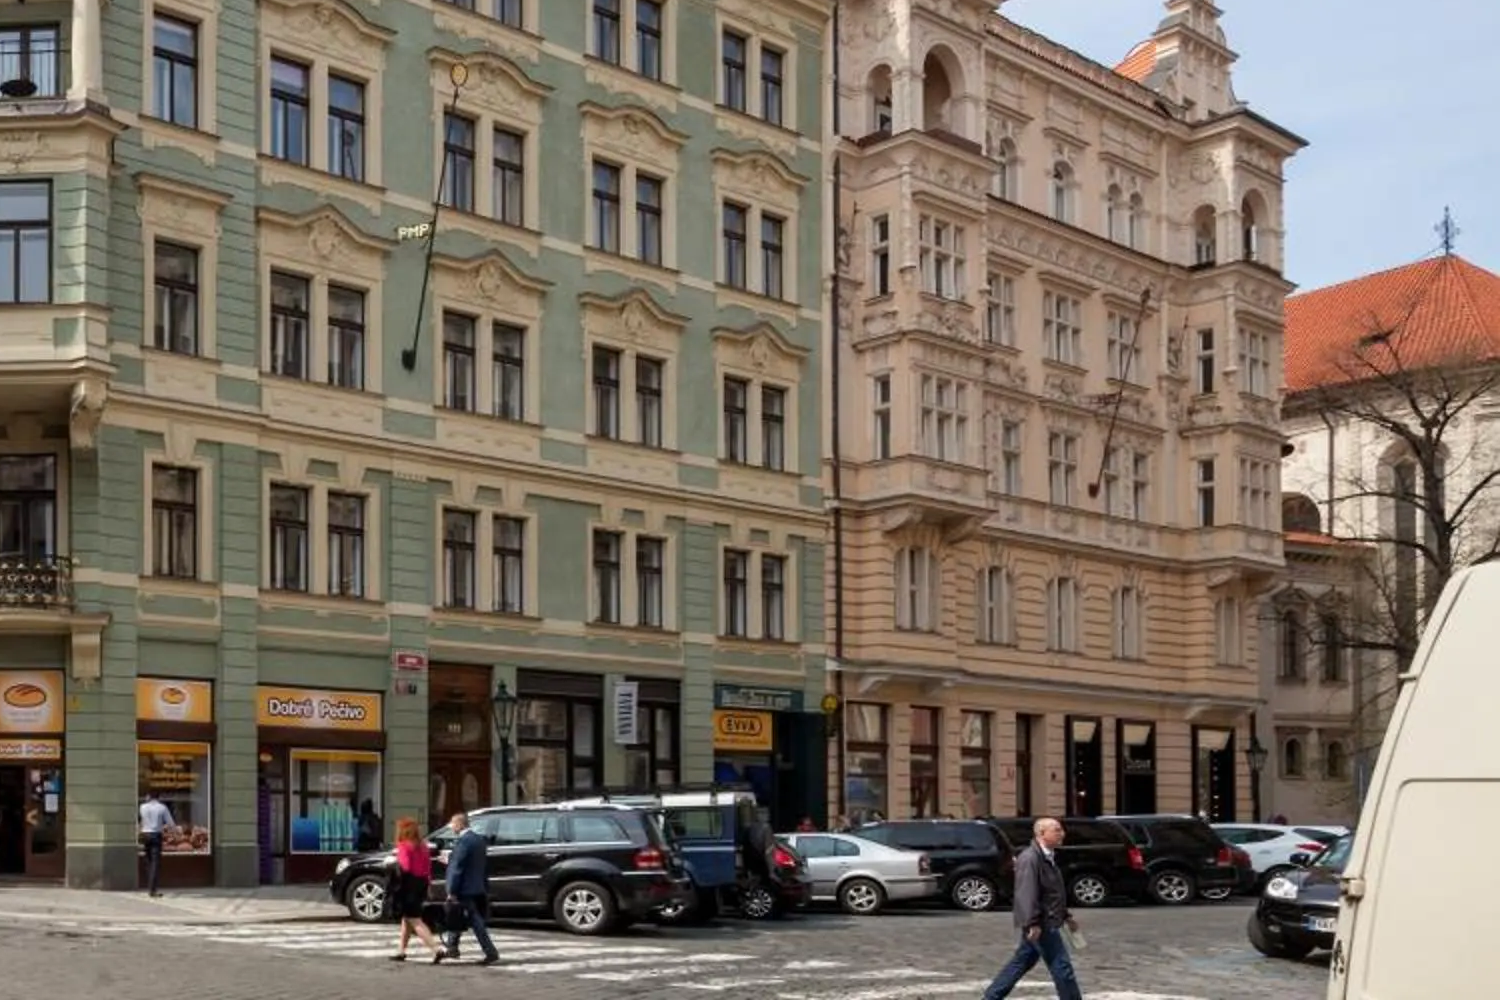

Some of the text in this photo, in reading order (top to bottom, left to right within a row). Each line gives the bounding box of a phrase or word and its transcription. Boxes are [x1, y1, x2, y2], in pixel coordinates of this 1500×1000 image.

[268, 698, 367, 720] Dobré Pečivo
[725, 716, 758, 733] EVVA
